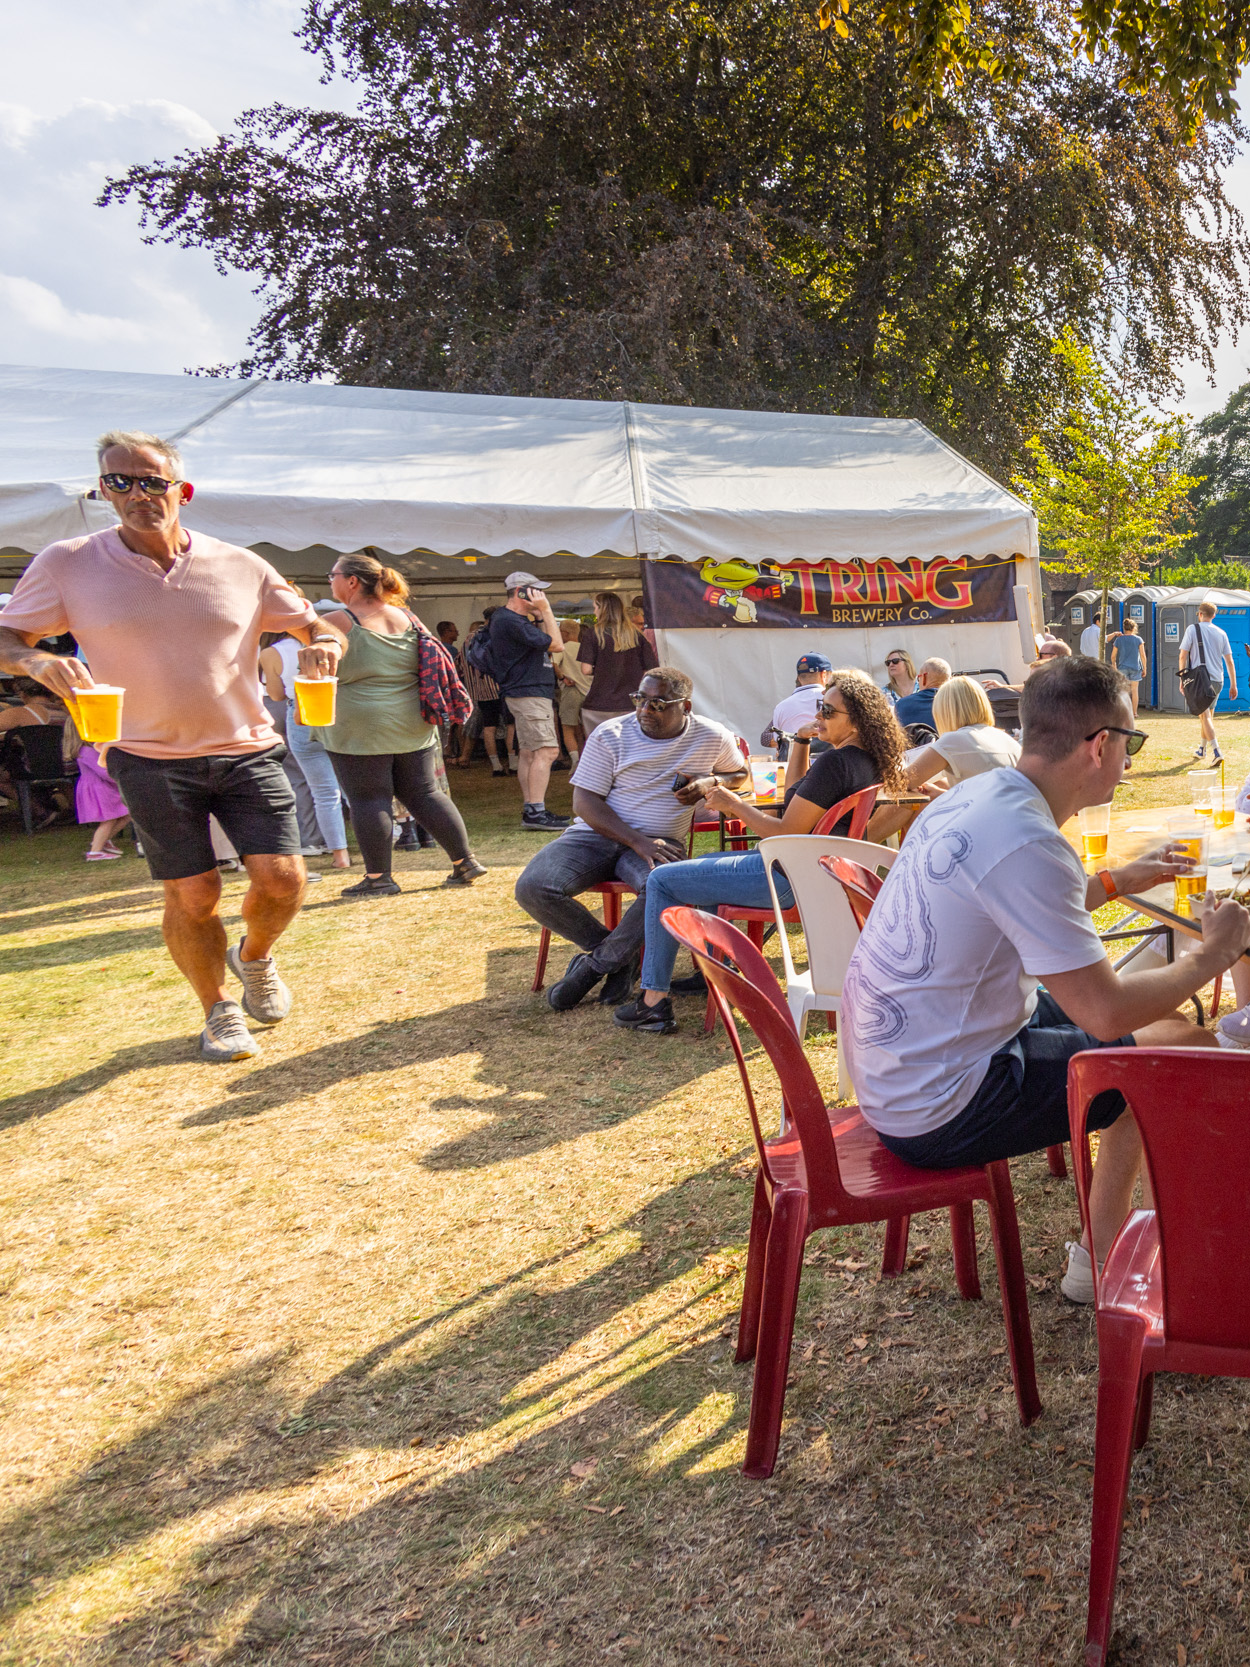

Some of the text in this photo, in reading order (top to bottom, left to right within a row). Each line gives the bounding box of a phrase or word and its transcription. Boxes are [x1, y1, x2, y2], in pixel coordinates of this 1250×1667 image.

[776, 557, 974, 615] TRING
[832, 606, 932, 622] BREWERY Co.
[1072, 609, 1081, 617] WC
[1131, 607, 1141, 615] WC
[1166, 625, 1177, 634] WC
